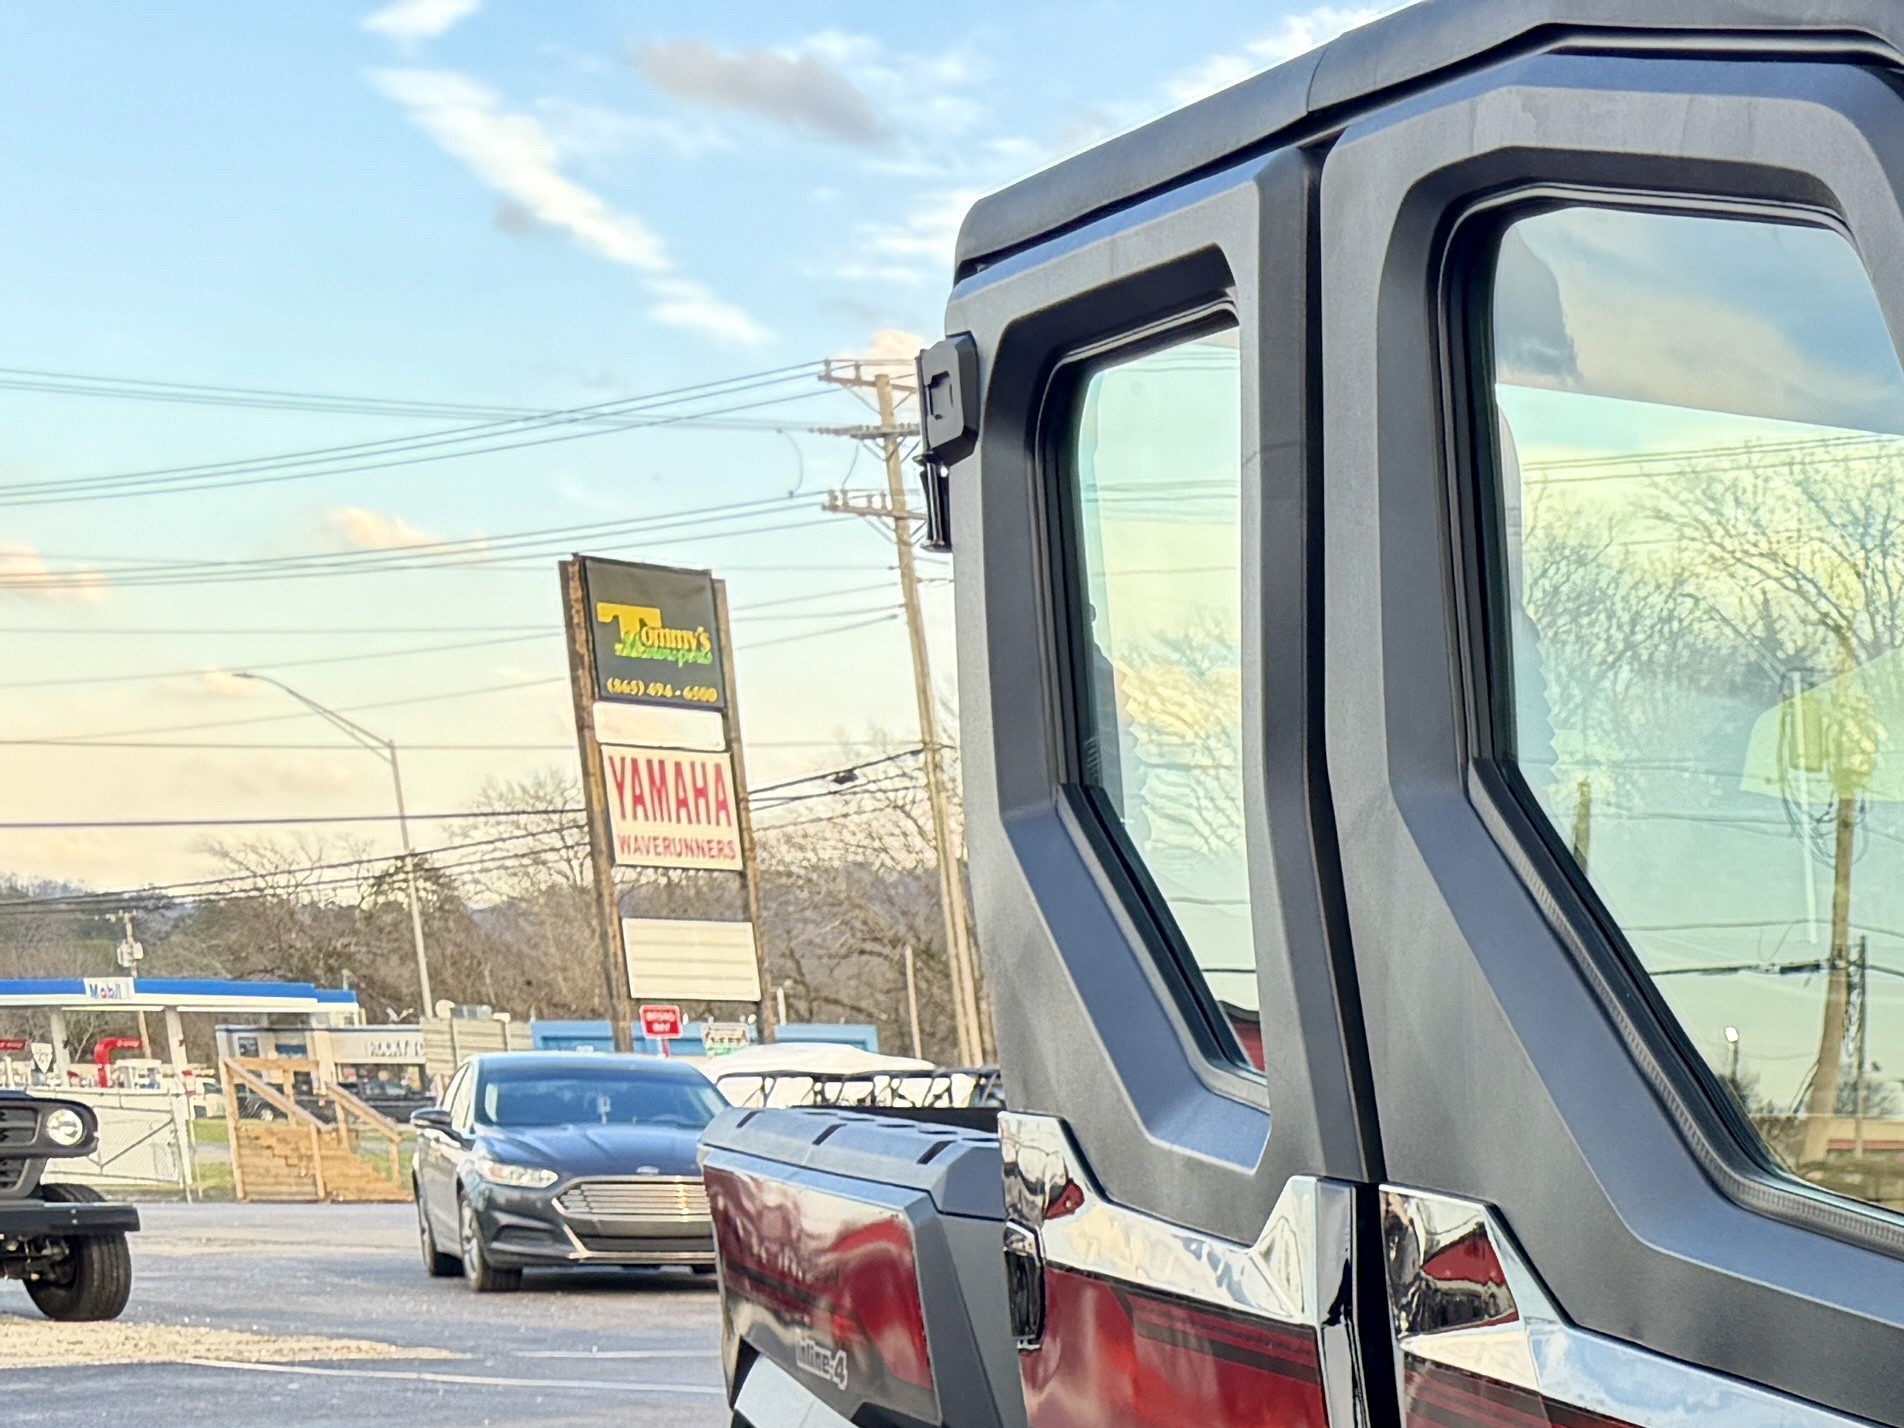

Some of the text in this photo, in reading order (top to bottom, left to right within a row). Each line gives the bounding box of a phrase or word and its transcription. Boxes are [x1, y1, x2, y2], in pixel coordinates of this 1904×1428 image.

[596, 602, 711, 654] Tommy's
[608, 755, 732, 827] YAMAHA
[617, 834, 736, 860] WAVERUNNERS
